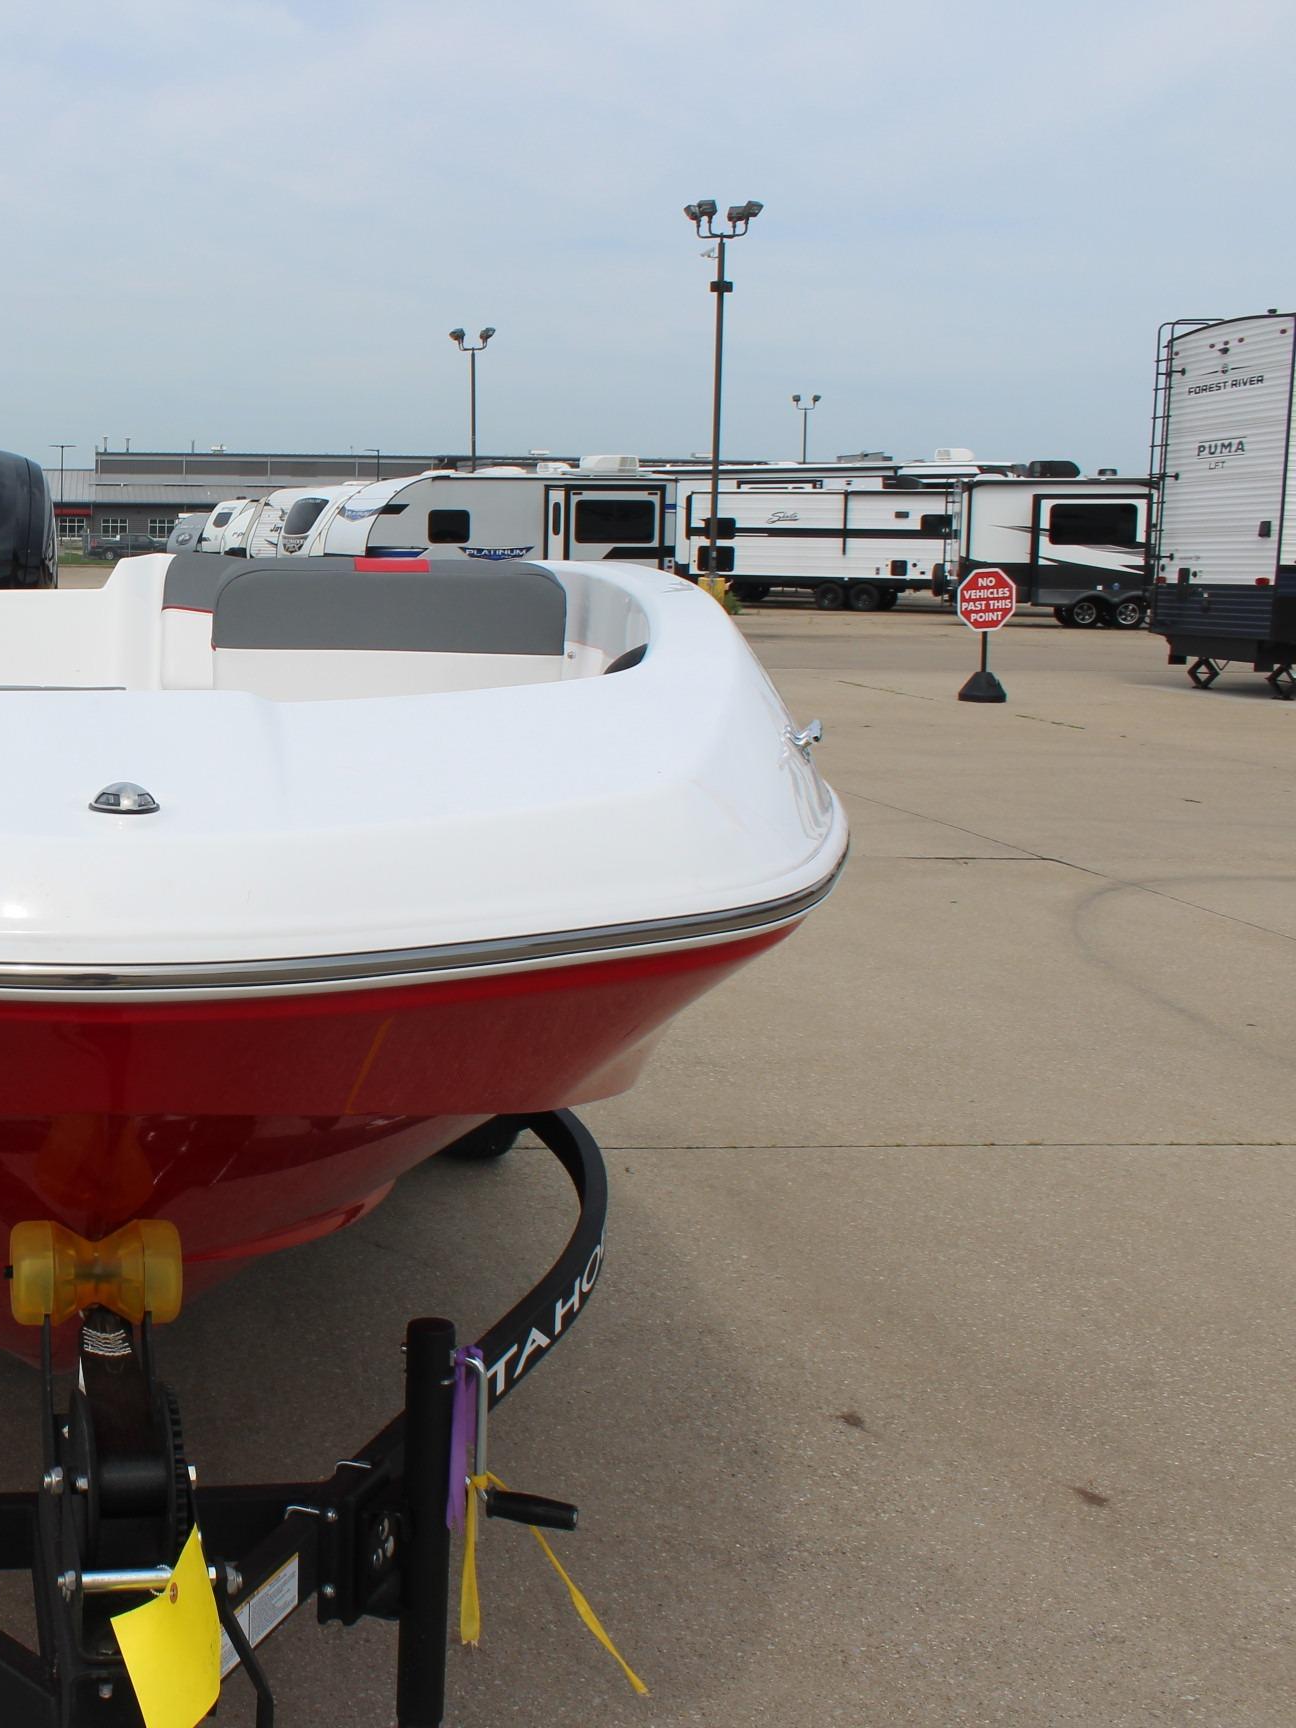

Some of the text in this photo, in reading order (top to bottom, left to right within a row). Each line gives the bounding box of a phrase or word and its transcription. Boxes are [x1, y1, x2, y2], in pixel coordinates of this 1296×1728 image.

[1188, 375, 1265, 395] FOREST RIVER
[1197, 440, 1246, 456] PUMA
[977, 577, 996, 587] NO
[963, 588, 1010, 599] VEHICLES
[961, 600, 1012, 611] PAST THIS
[970, 612, 1003, 622] POINT
